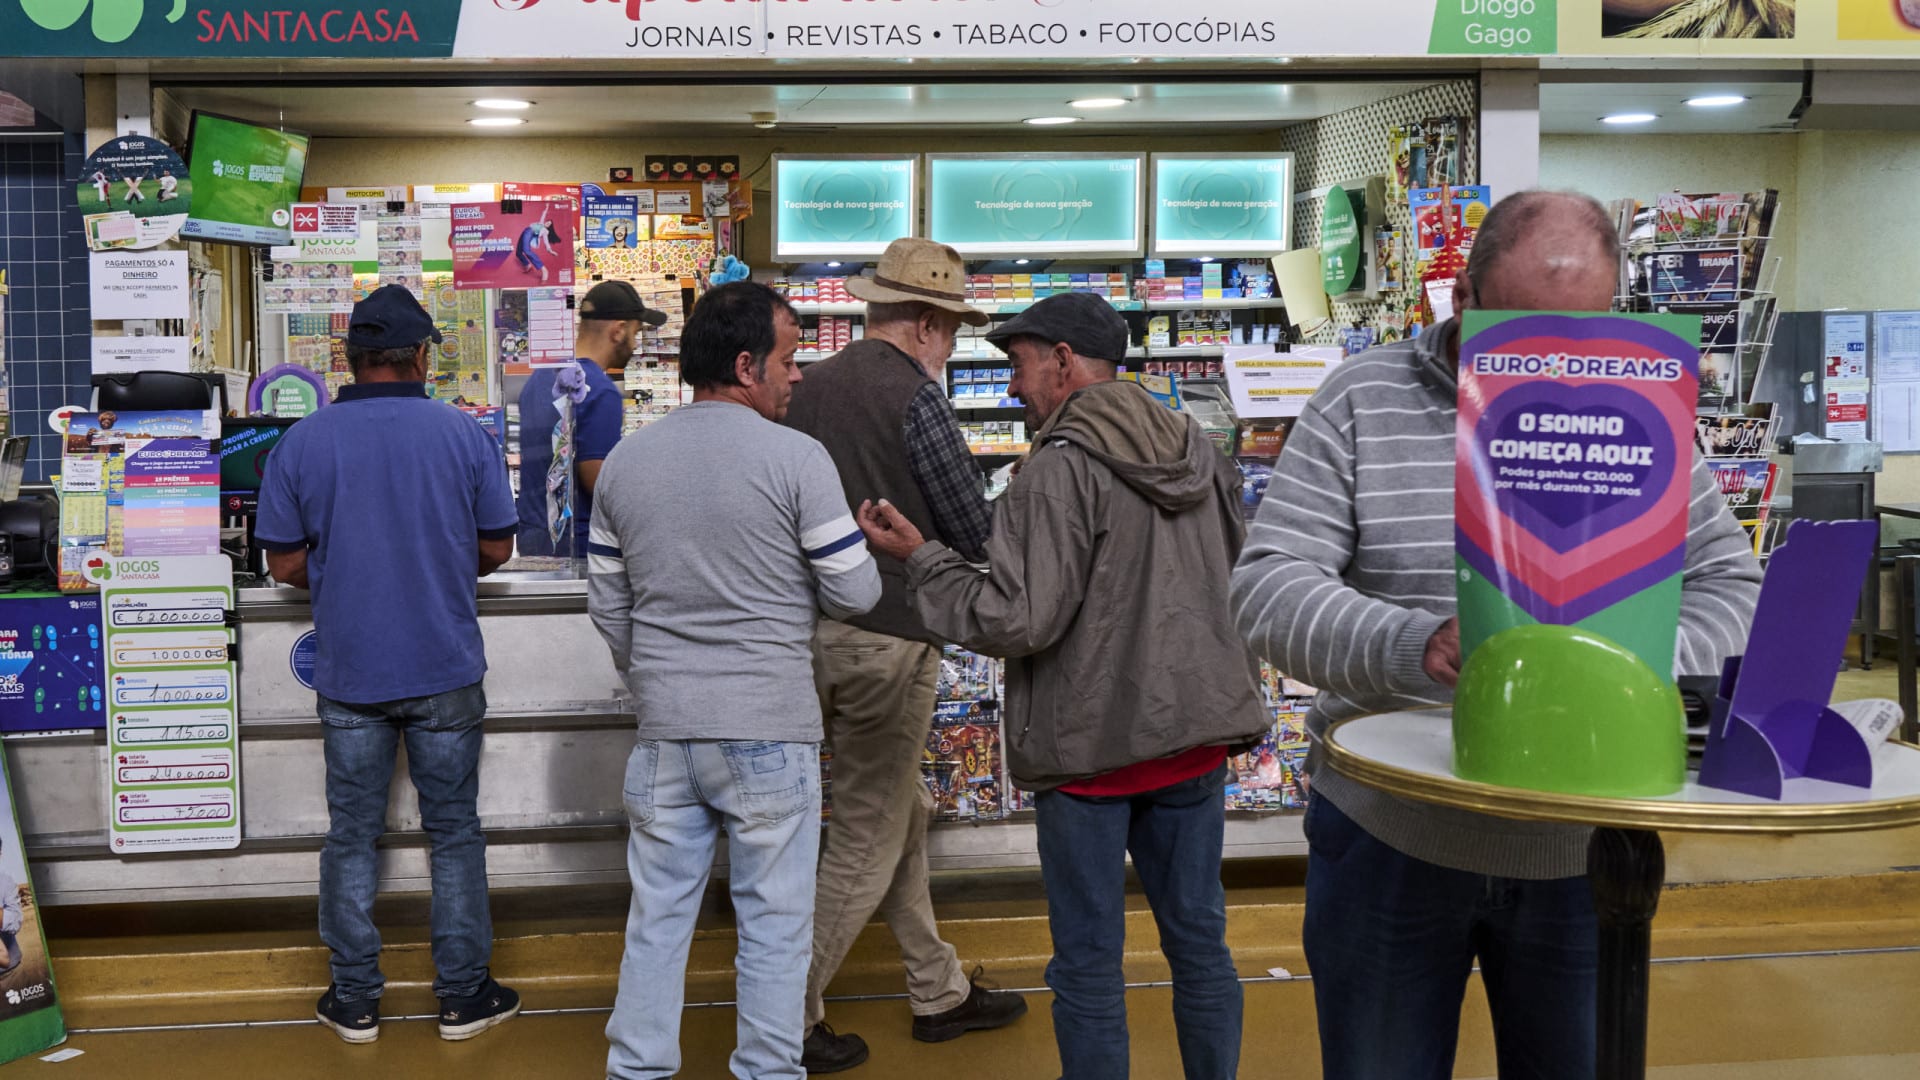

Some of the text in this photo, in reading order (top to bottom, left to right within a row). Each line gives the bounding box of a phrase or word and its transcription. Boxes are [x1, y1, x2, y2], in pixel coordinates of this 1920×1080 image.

[1460, 0, 1535, 18] Diogo
[196, 8, 420, 43] SANTACASA
[625, 16, 1277, 48] JORNAIS REVISTAS TABACO FOTOCÓPIAS
[1464, 23, 1532, 48] Gago
[224, 165, 245, 177] JOGOS
[784, 201, 832, 211] Tecnologia
[869, 201, 904, 211] geração
[975, 200, 1022, 210] Tecnologia
[1058, 199, 1093, 210] geração
[1162, 199, 1208, 209] Tecnologia
[1210, 199, 1220, 207] de
[1244, 200, 1279, 209] geração
[307, 248, 356, 256] SANTACASA
[158, 258, 167, 266] SÓ
[1474, 355, 1680, 379] EURO DREAMS
[1518, 413, 1624, 436] O SONHO
[220, 444, 243, 459] JOGAR
[250, 428, 279, 445] CRÉDITO
[222, 428, 256, 445] PROIBIDO
[1490, 439, 1653, 466] COMEÇA AQUI
[1500, 467, 1634, 483] Podes ganhar €20.000
[1495, 479, 1641, 497] por mês durante 30 anos
[116, 561, 160, 576] JOGOS
[0, 641, 15, 650] ÇA
[0, 650, 34, 660] TÓRIA
[20, 984, 44, 1000] JOGOS
